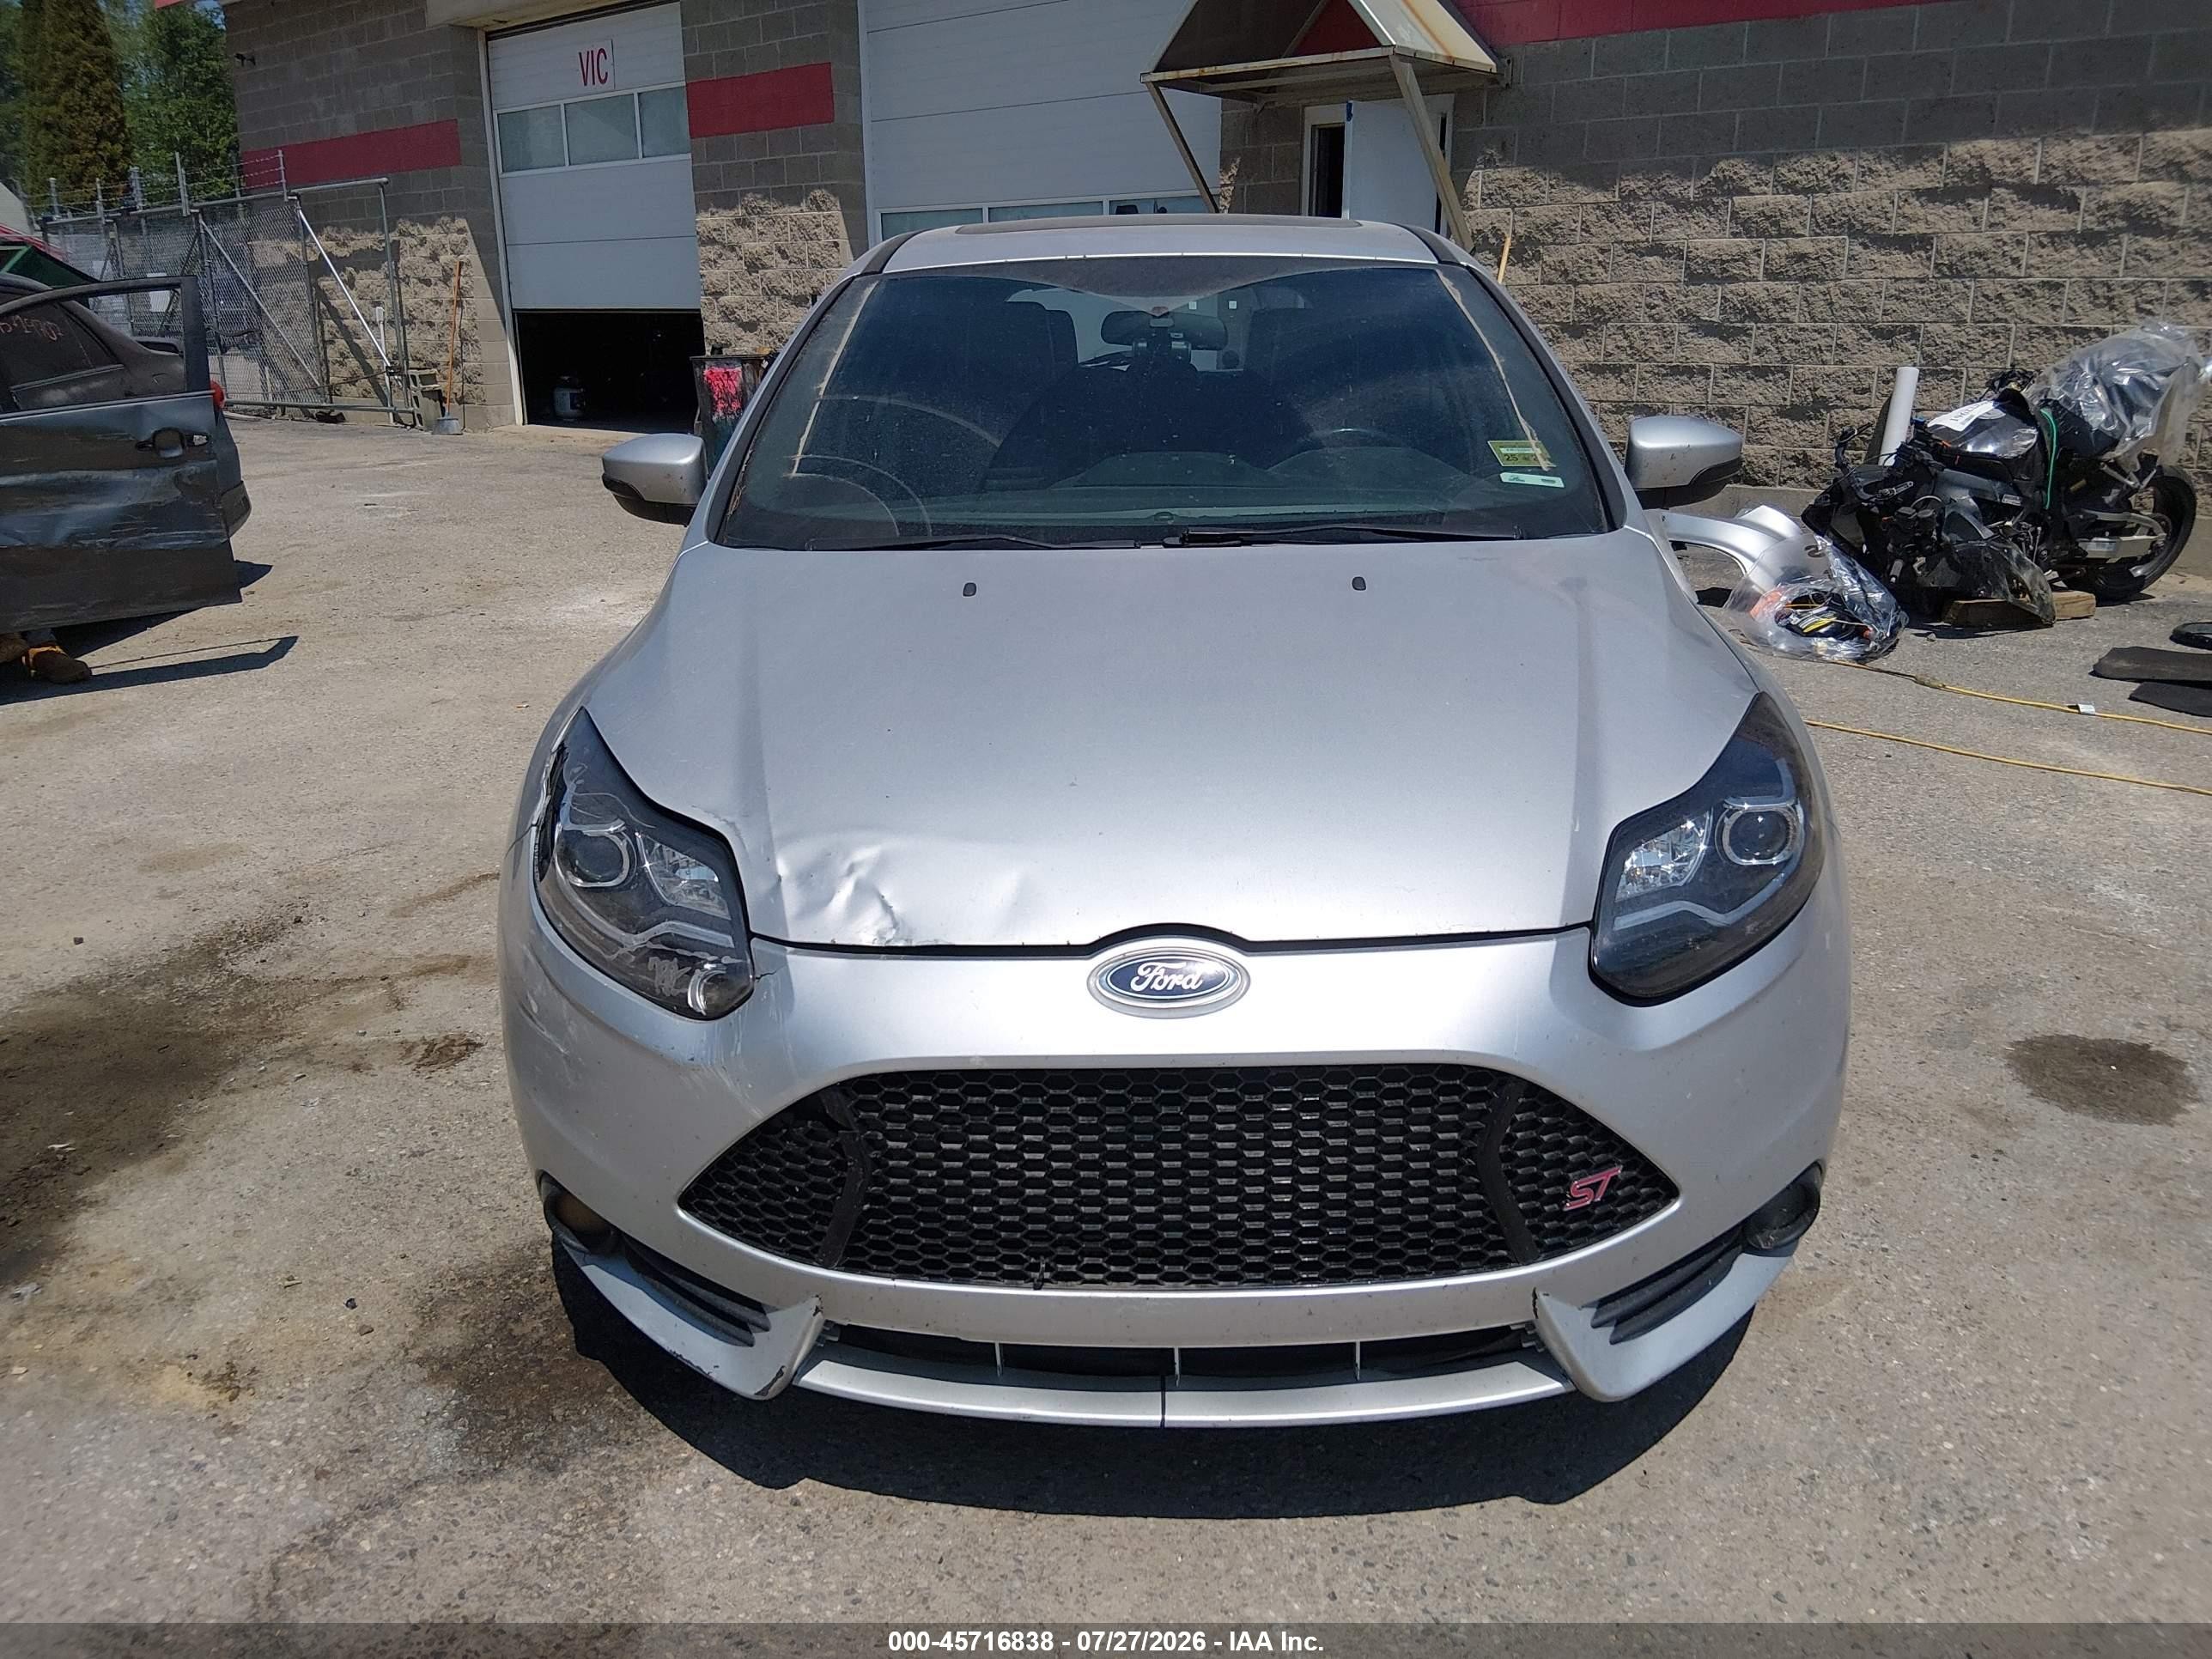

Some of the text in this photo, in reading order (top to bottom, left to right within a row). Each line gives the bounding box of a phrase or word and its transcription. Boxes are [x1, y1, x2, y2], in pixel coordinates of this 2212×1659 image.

[578, 48, 608, 87] VIC
[1130, 961, 1205, 992] Ford
[1564, 1165, 1623, 1212] ST
